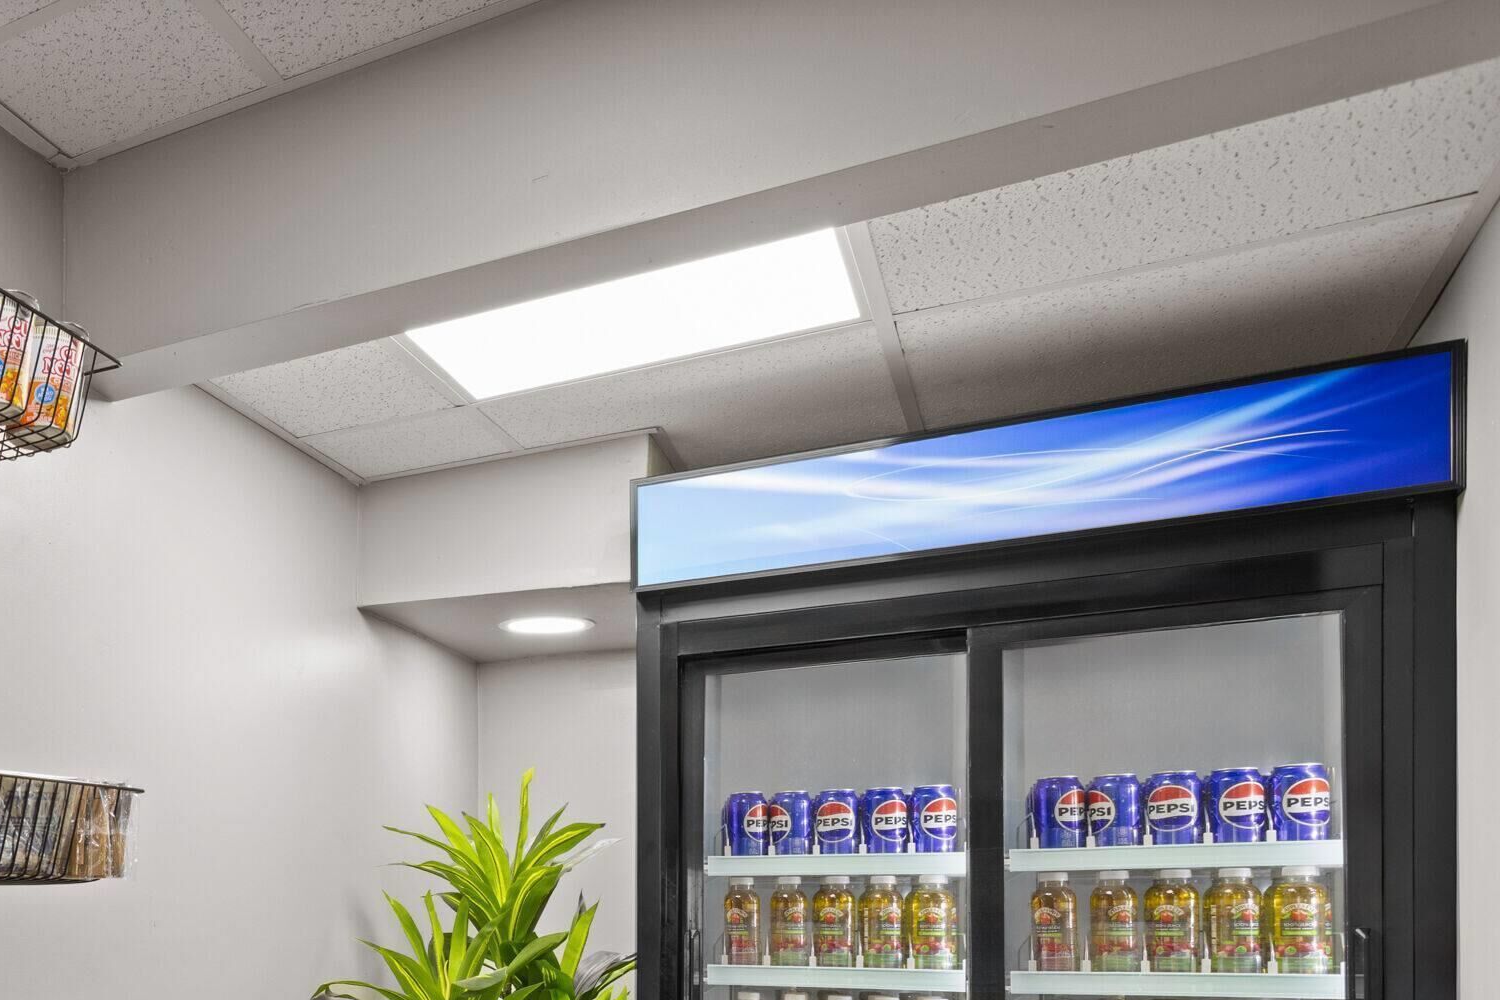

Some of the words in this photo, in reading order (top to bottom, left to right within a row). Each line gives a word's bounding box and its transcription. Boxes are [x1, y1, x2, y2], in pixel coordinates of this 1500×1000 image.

[1222, 799, 1266, 812] PEPS
[1286, 795, 1331, 808] PEPS
[1148, 803, 1195, 814] PEPSI
[817, 818, 853, 828] PEPSI
[874, 815, 907, 827] PEPS
[923, 813, 957, 824] PEPS
